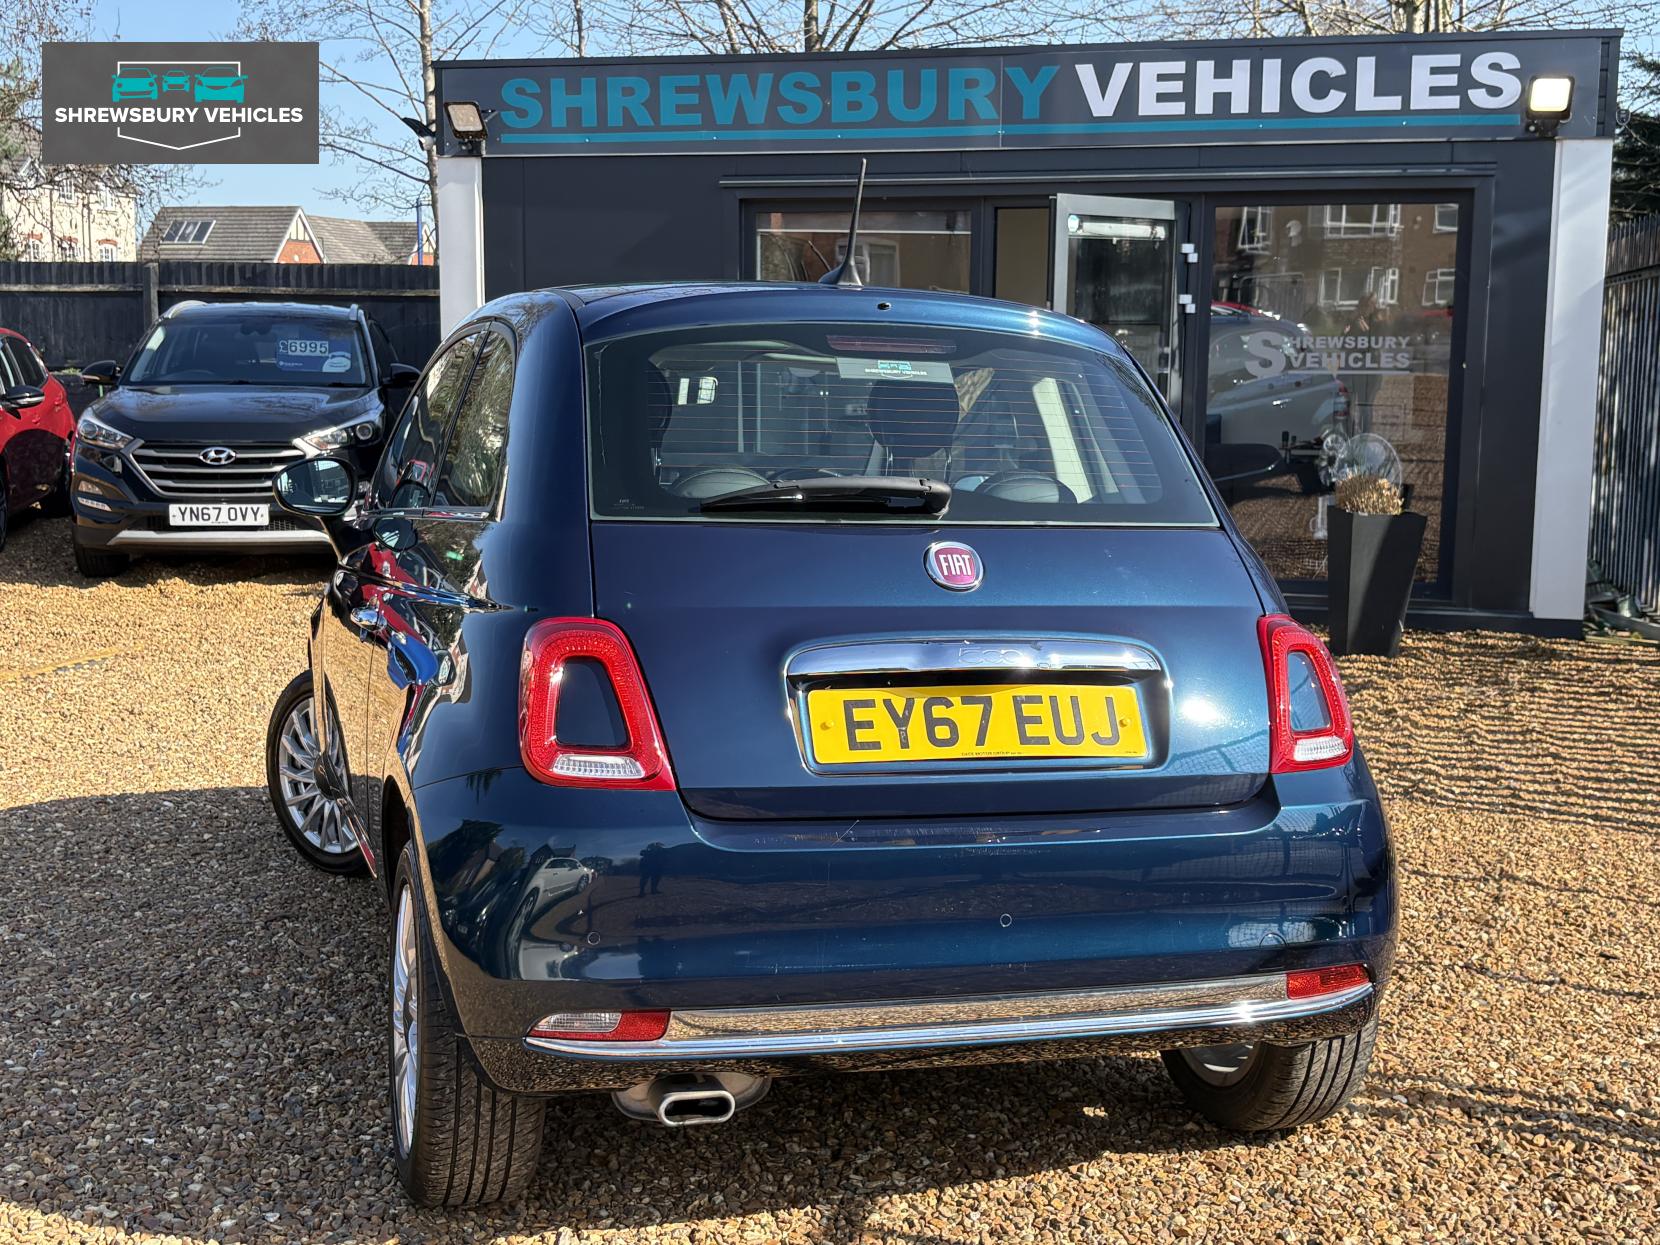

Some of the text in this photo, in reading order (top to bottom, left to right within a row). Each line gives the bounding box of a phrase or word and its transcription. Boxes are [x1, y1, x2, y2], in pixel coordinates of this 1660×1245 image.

[501, 52, 1521, 129] SHREWSBURY VEHICLES
[280, 340, 328, 355] £6995
[1288, 352, 1410, 369] VEHICLES
[178, 506, 260, 522] YN67 OVY
[938, 554, 972, 576] FIAT
[843, 695, 1121, 751] EY67 EUJ
